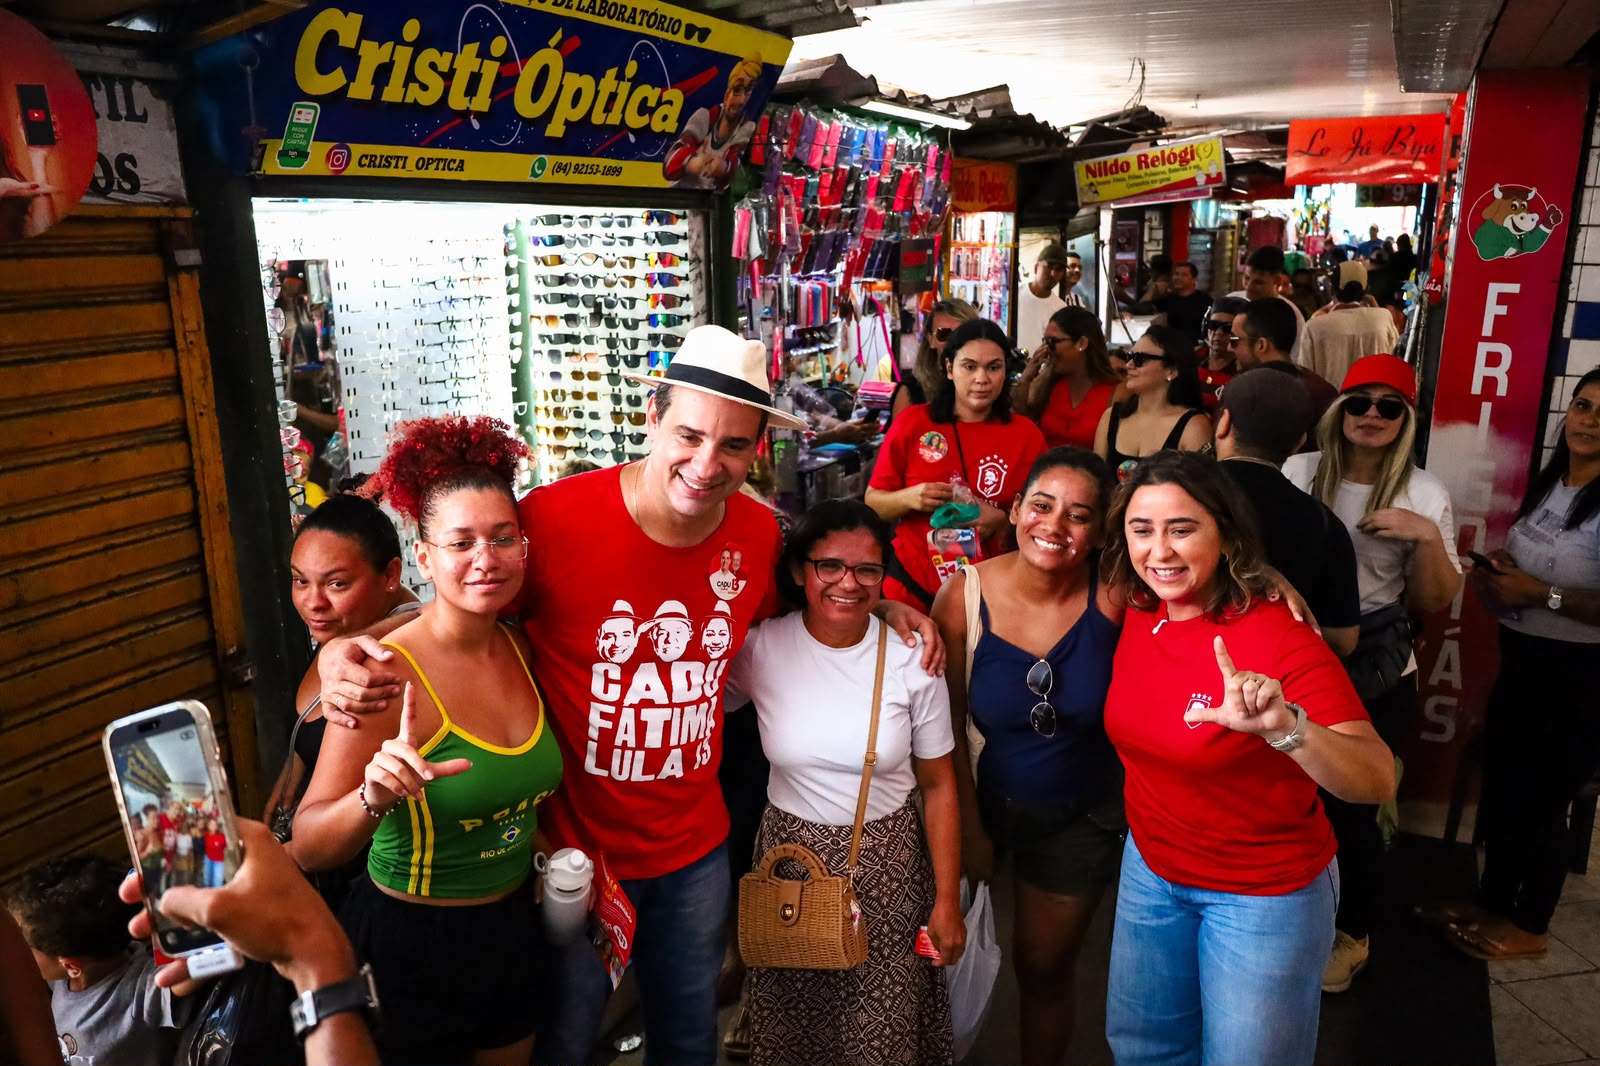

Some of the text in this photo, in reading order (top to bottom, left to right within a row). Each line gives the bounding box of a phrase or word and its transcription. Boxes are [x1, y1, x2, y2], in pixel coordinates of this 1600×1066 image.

[575, 0, 682, 36] LABORATÓRIO
[295, 7, 685, 138] Cristi Óptica
[357, 153, 466, 173] CRISTI_OPTICA
[551, 159, 623, 178] (84) 92153-1899
[1084, 158, 1131, 180] Nildo
[716, 580, 731, 589] CADU
[590, 658, 729, 707] CADU
[584, 740, 684, 782] LULA
[480, 849, 496, 859] RIO
